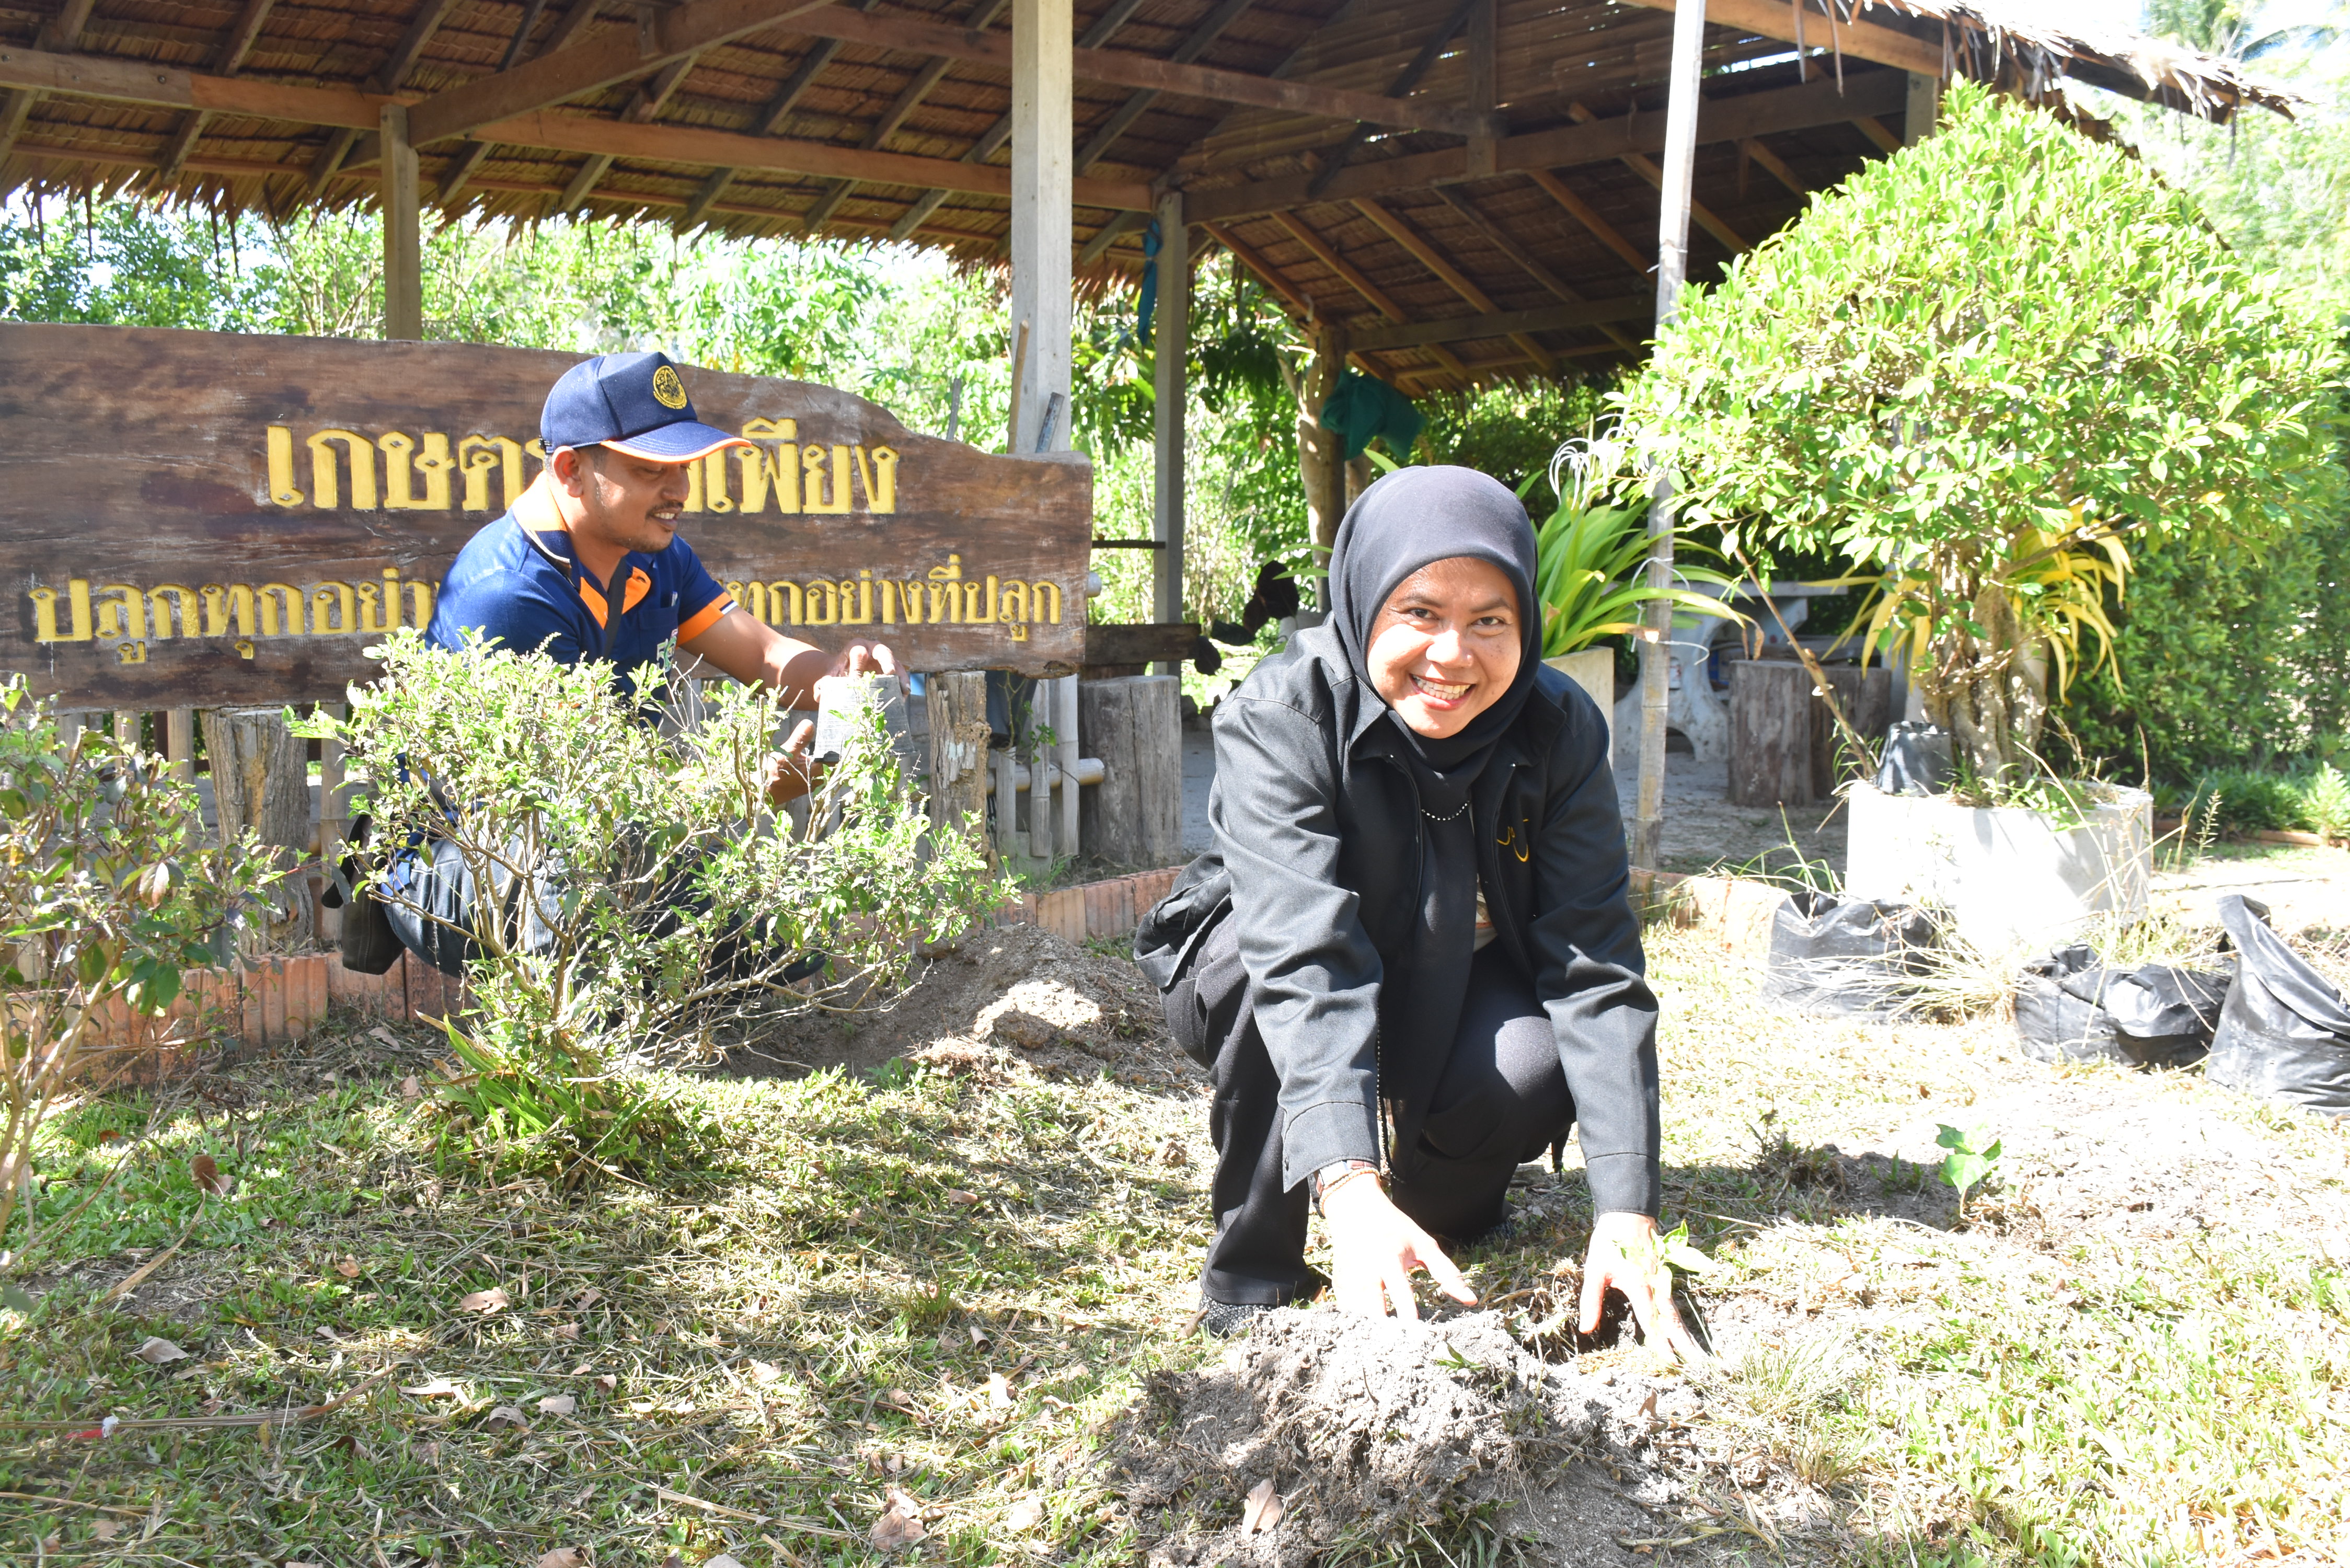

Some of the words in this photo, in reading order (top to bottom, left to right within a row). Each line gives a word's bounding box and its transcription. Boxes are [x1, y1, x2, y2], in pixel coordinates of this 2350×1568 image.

[29, 567, 440, 664] ปลูกทุกอย่า
